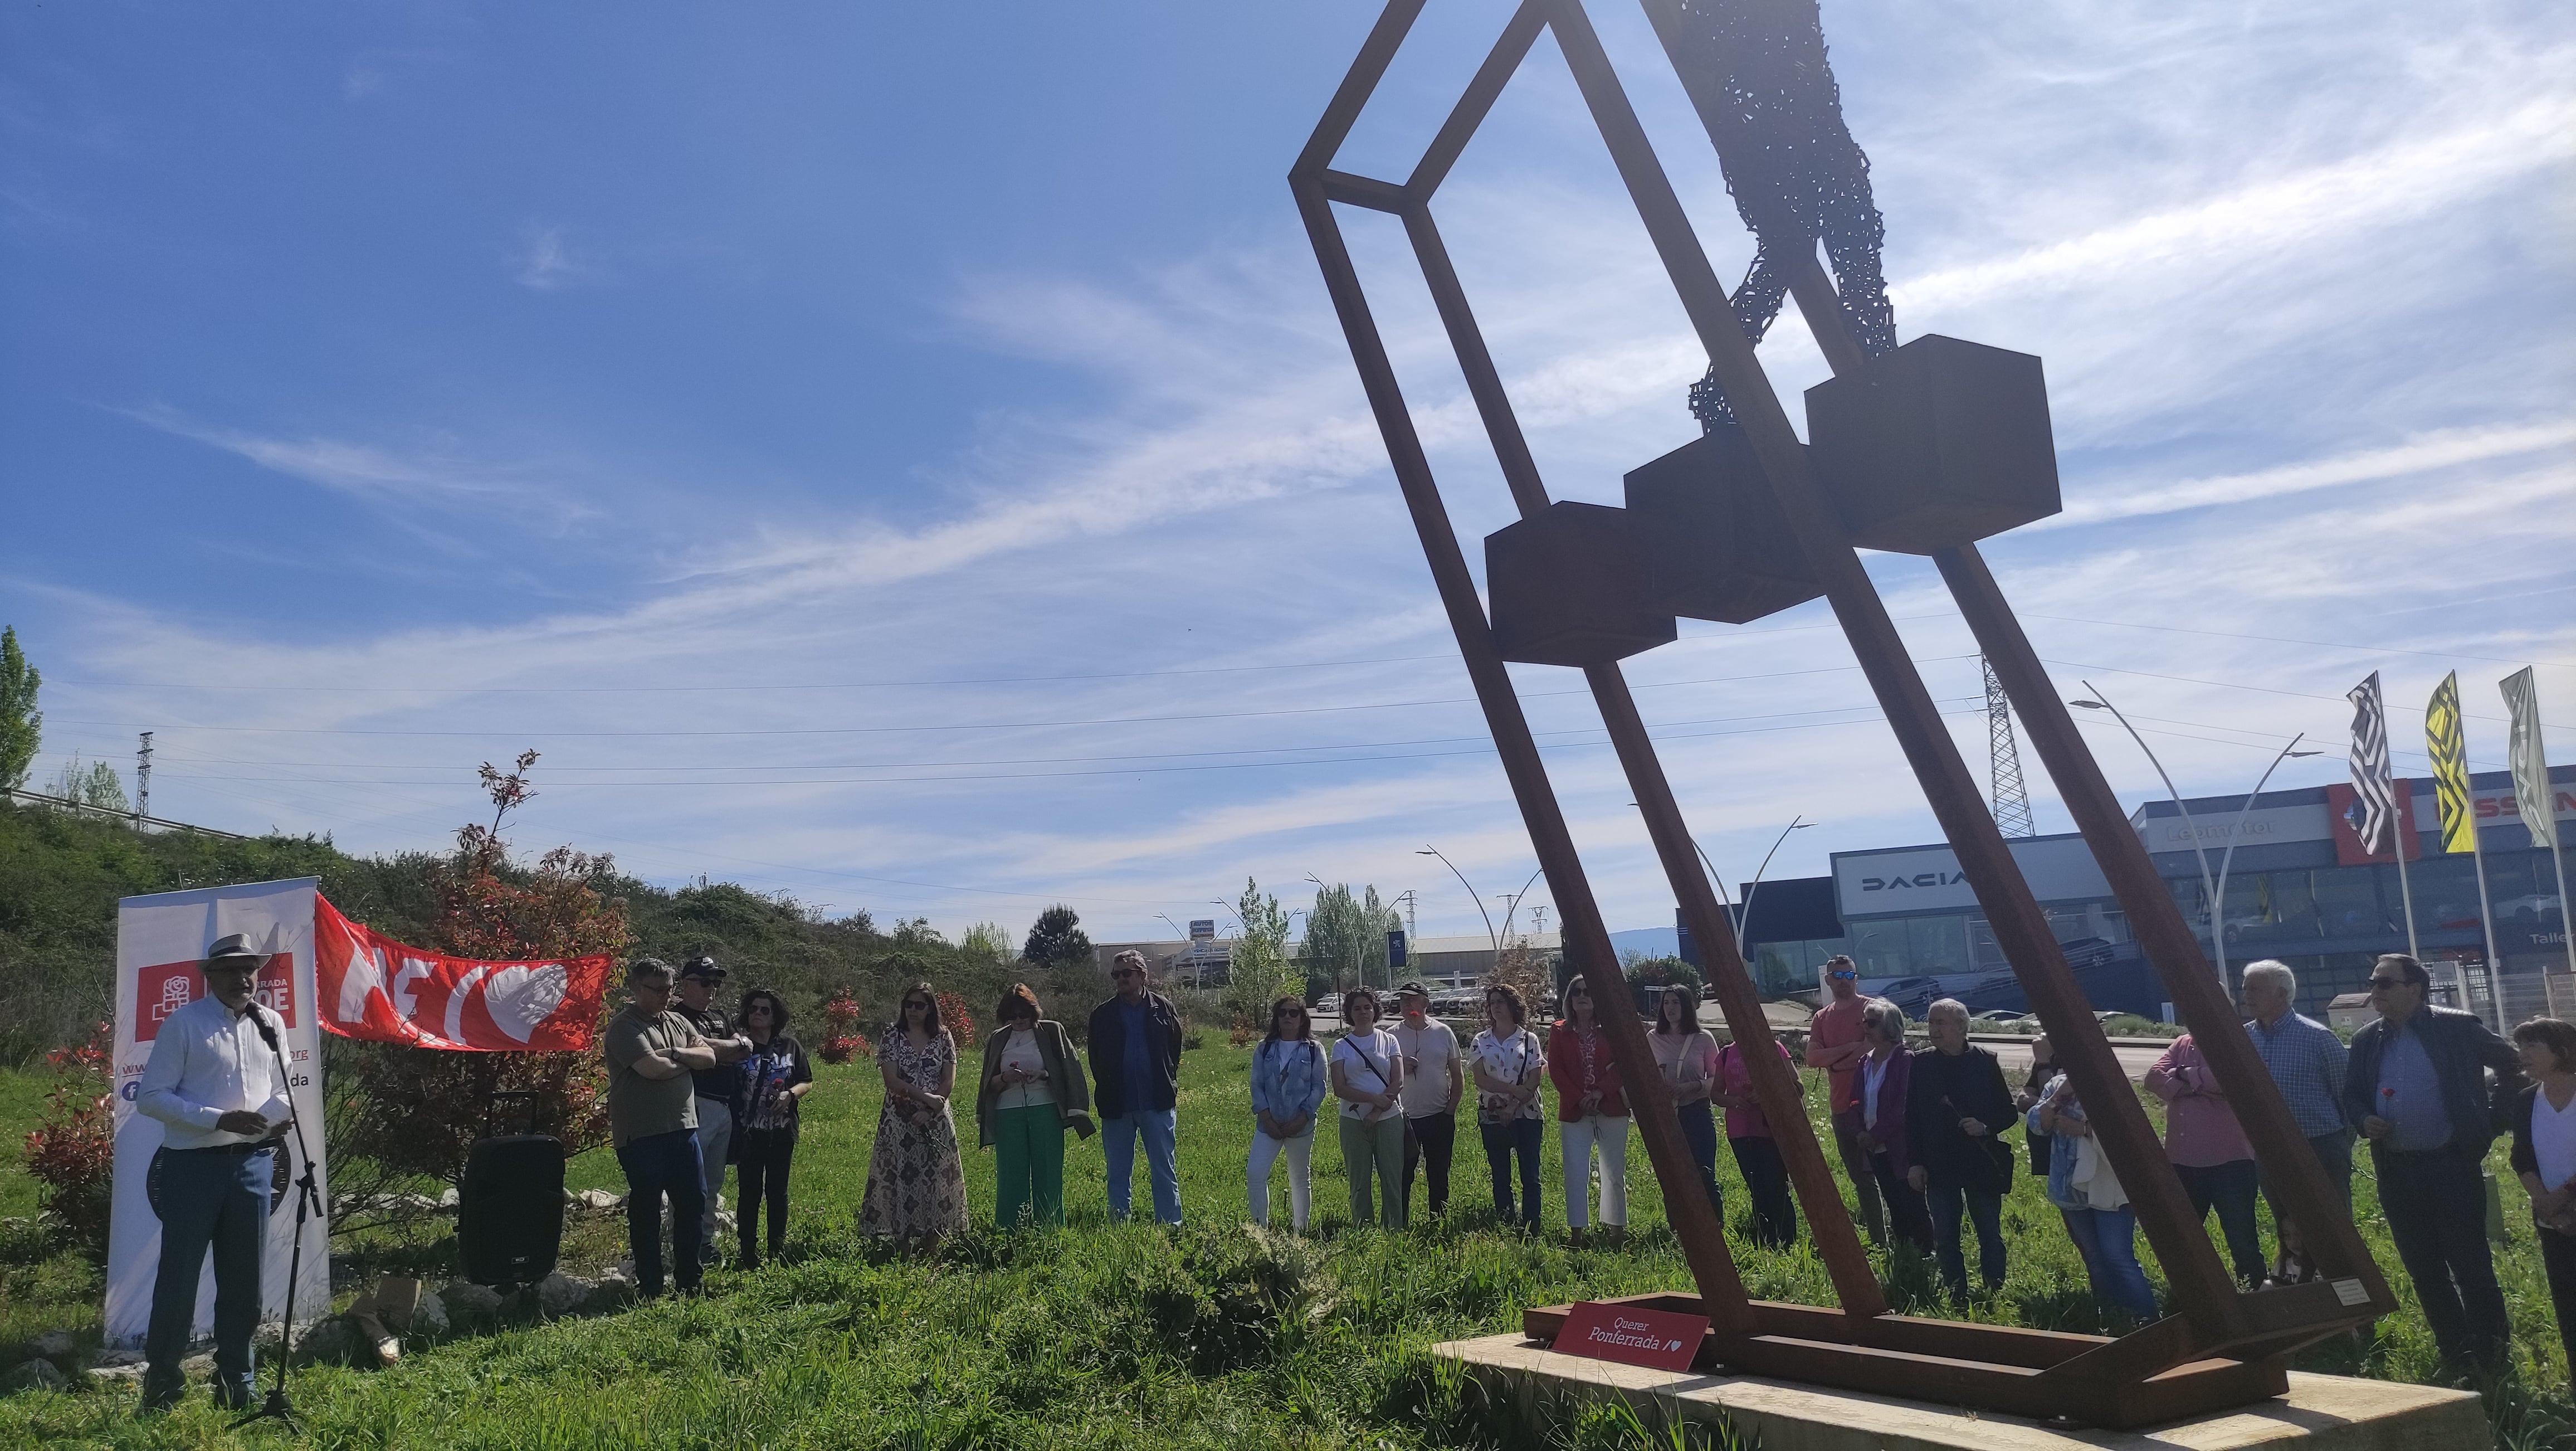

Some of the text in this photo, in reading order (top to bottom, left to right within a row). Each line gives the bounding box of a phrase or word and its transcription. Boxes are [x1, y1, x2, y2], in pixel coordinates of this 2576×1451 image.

[1862, 871, 1970, 892] DACIA
[256, 978, 287, 988] RRADA
[255, 988, 289, 1011] OE
[1614, 1317, 1649, 1331] Querer
[1588, 1326, 1660, 1350] Ponferrada
